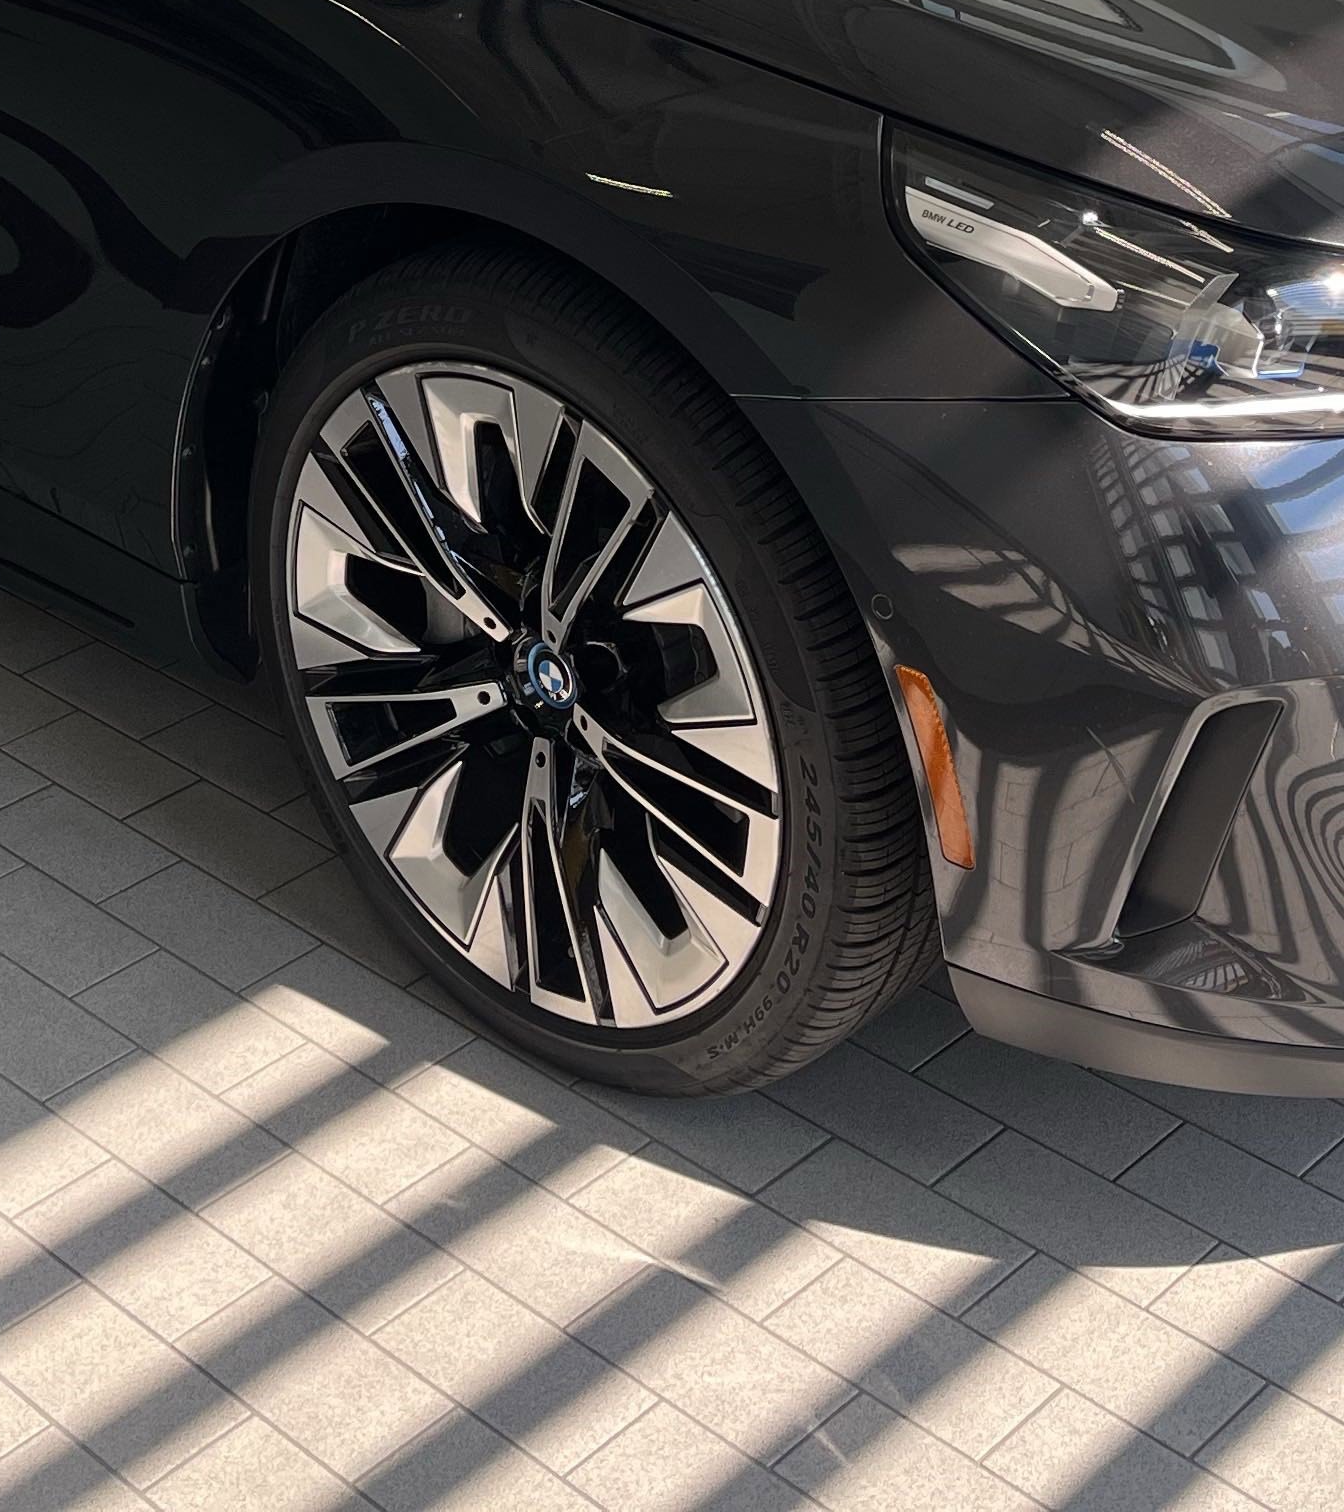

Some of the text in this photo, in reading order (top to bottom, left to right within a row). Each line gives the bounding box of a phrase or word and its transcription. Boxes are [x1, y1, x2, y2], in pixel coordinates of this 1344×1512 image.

[922, 209, 975, 234] BMW LED
[799, 754, 823, 920] 245/40
[775, 922, 810, 995] R20
[744, 994, 773, 1031] 99H
